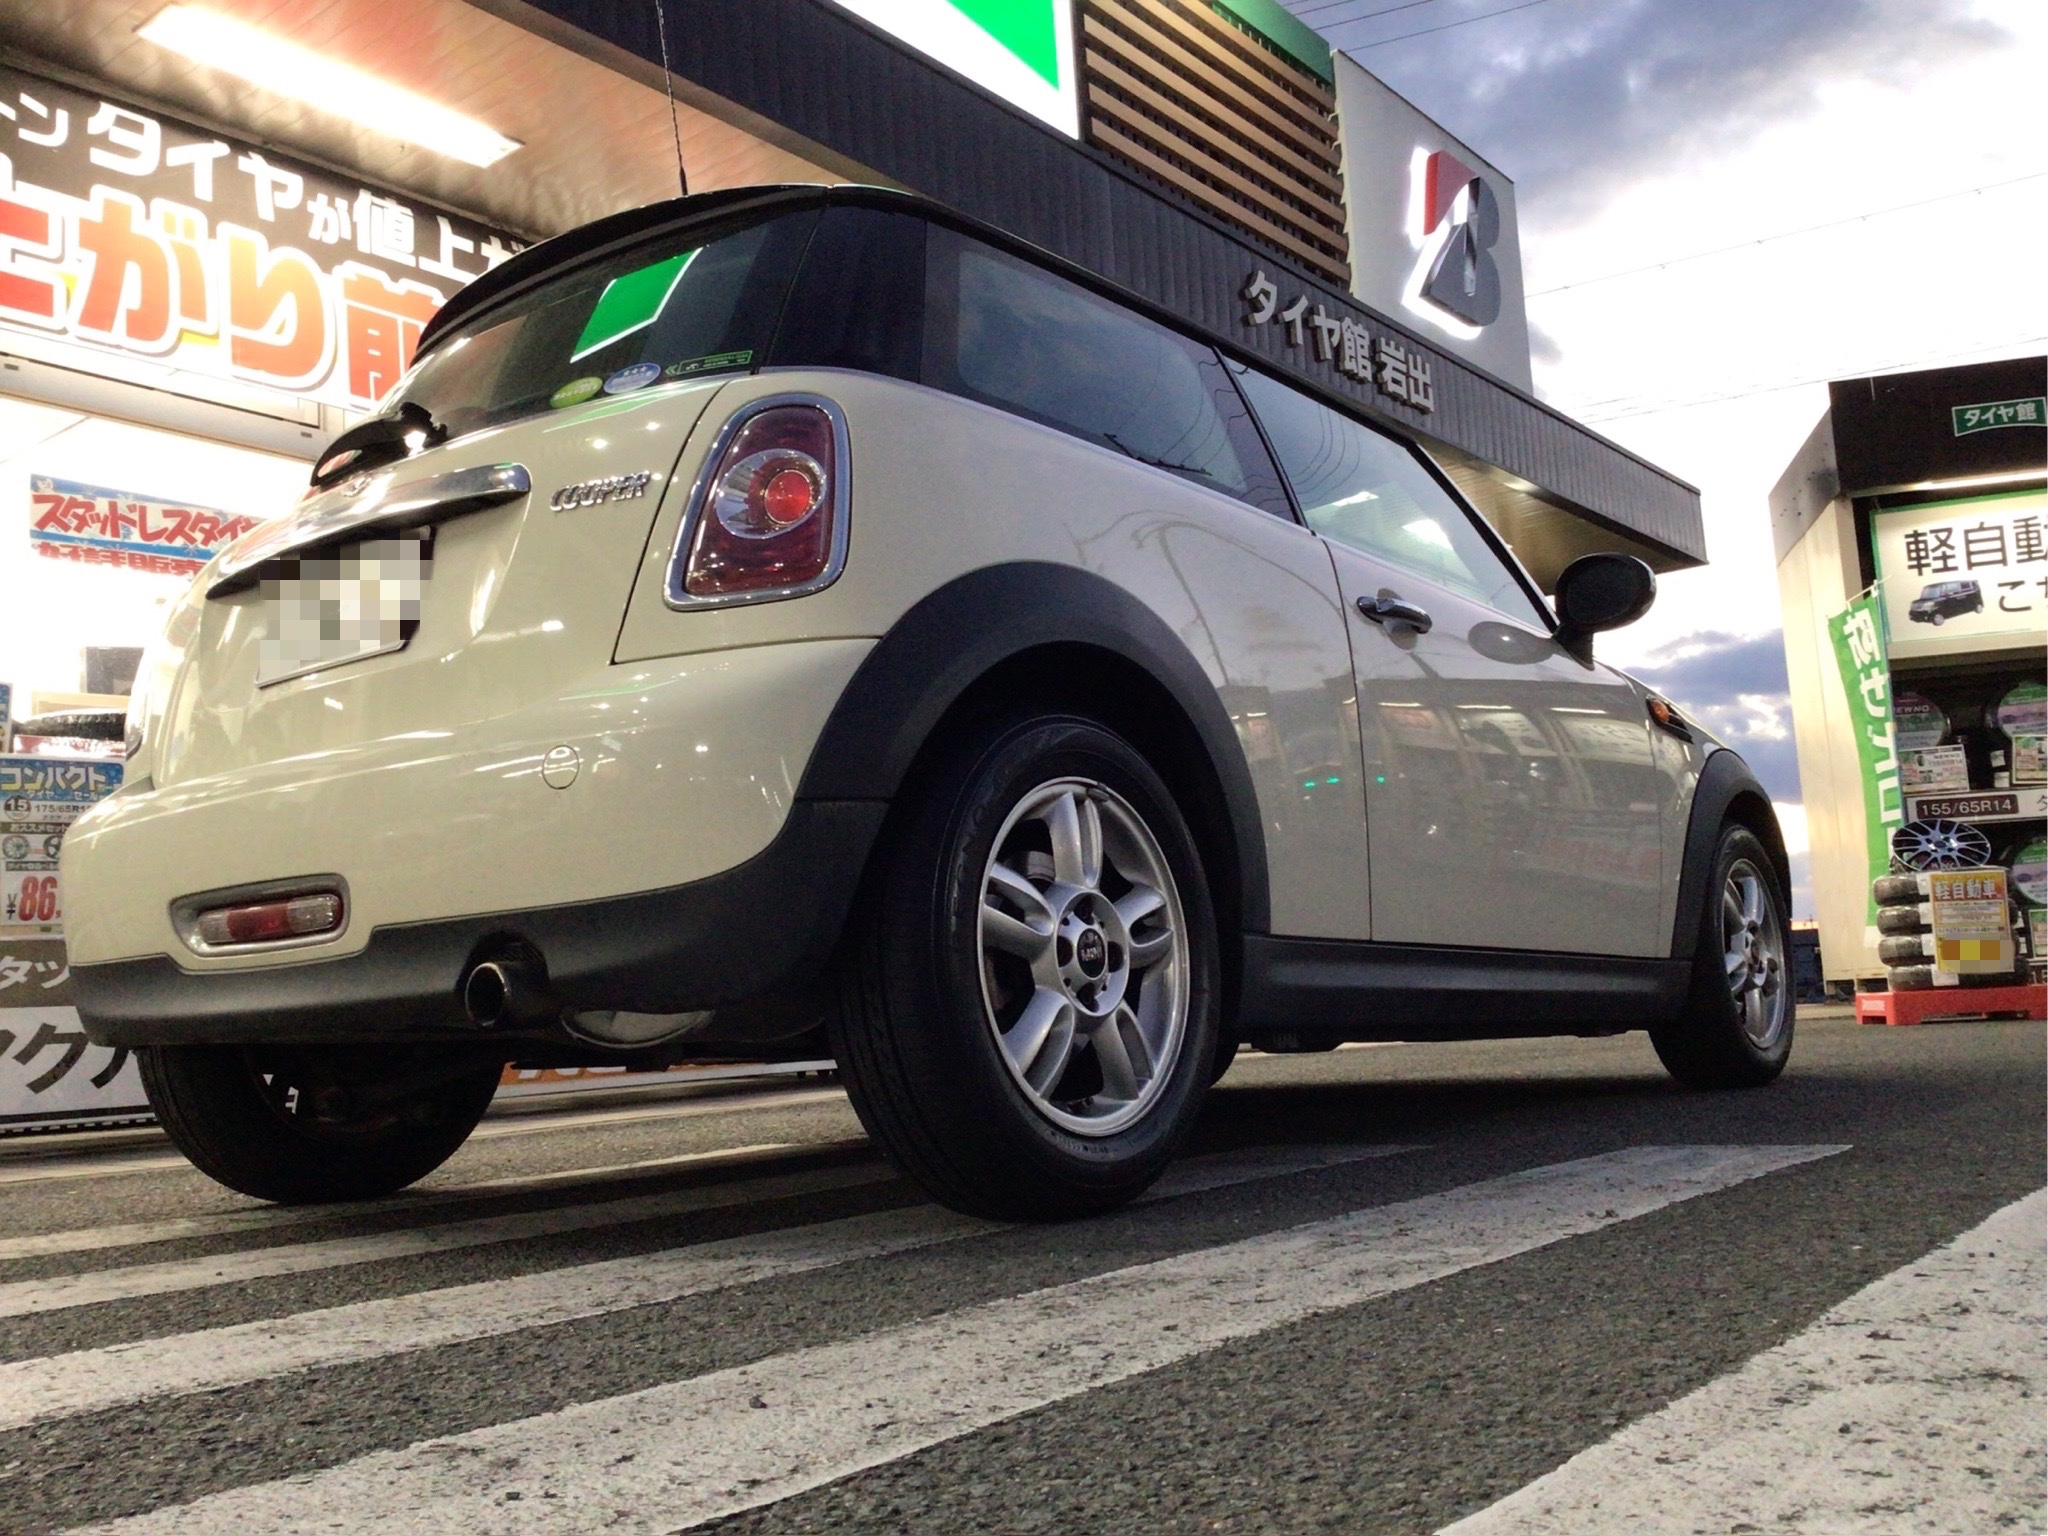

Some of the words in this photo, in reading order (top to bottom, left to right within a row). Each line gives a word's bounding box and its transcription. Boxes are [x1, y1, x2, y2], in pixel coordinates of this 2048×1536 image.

[1248, 270, 1372, 382] タイヤ館
[1377, 336, 1434, 413] 岩出
[1963, 402, 2037, 427] タイヤ館
[549, 470, 651, 512] COOPER
[0, 766, 106, 791] コンパクト
[7, 798, 28, 810] 15
[1922, 799, 2012, 816] 155/65R14
